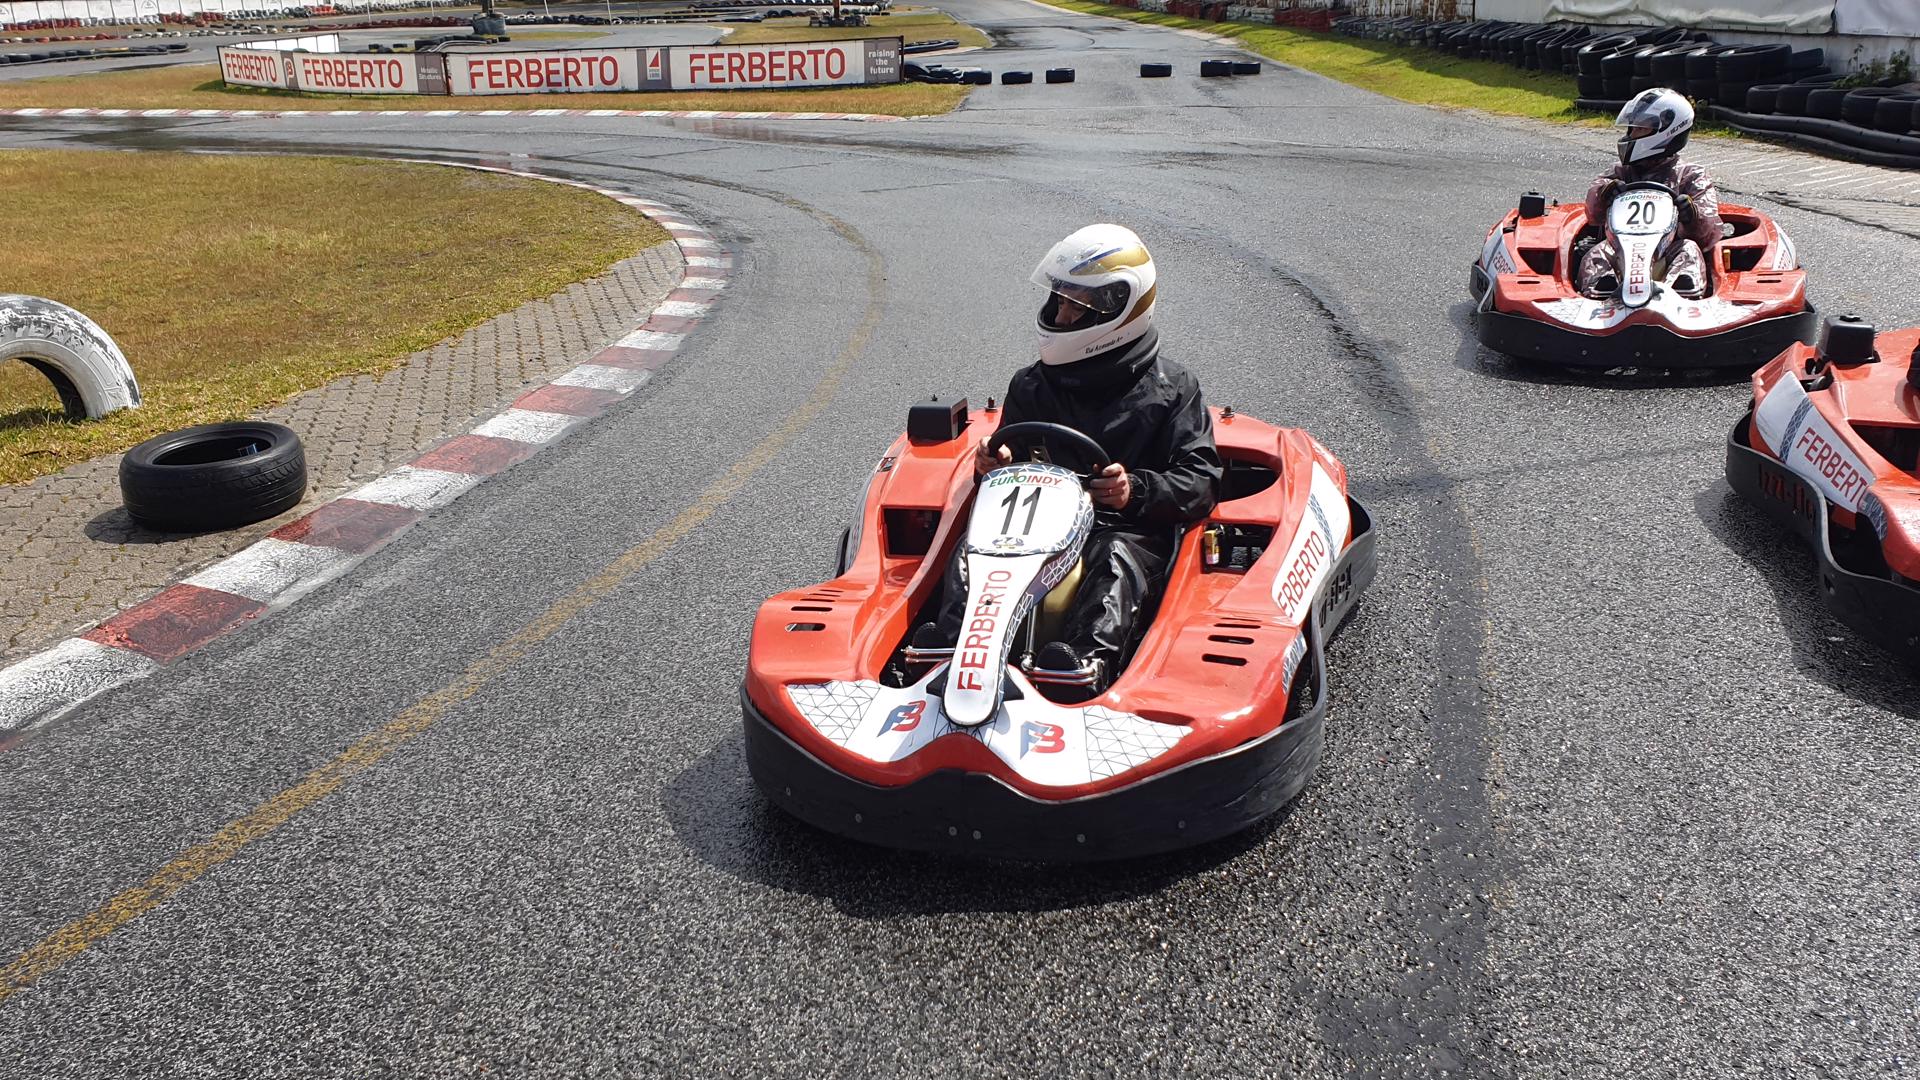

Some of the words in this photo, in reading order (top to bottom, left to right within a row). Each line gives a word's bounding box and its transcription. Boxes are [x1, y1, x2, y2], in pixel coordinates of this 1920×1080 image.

[224, 53, 278, 84] FERBERTO
[689, 48, 846, 84] FERBERTO
[868, 49, 895, 58] raising
[875, 58, 888, 66] the
[303, 58, 404, 88] FERBERTO
[469, 55, 619, 89] FERBERTO
[870, 66, 895, 74] future
[1620, 194, 1663, 202] EUROINDY
[1626, 201, 1656, 225] 20
[1630, 242, 1646, 295] FERBERTO
[989, 474, 1063, 489] EUROINDY
[1000, 486, 1042, 536] 11
[957, 569, 1012, 691] FERBERTO
